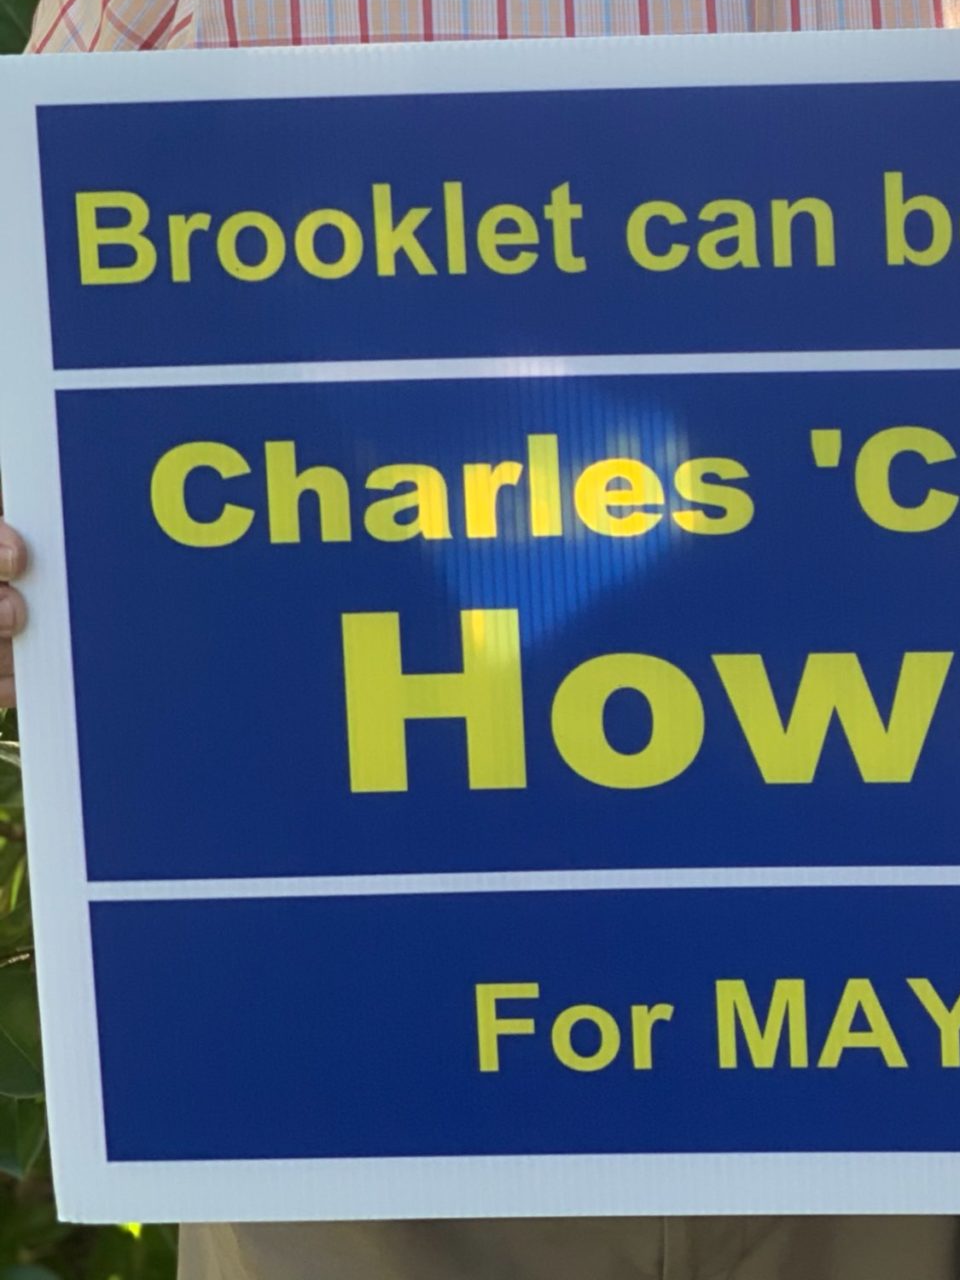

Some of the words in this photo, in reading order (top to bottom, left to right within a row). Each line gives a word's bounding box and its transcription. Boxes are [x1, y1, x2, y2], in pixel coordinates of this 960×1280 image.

[75, 181, 586, 285] Brooklet
[626, 197, 835, 271] can
[150, 433, 755, 547] Charles
[475, 982, 673, 1072] For
